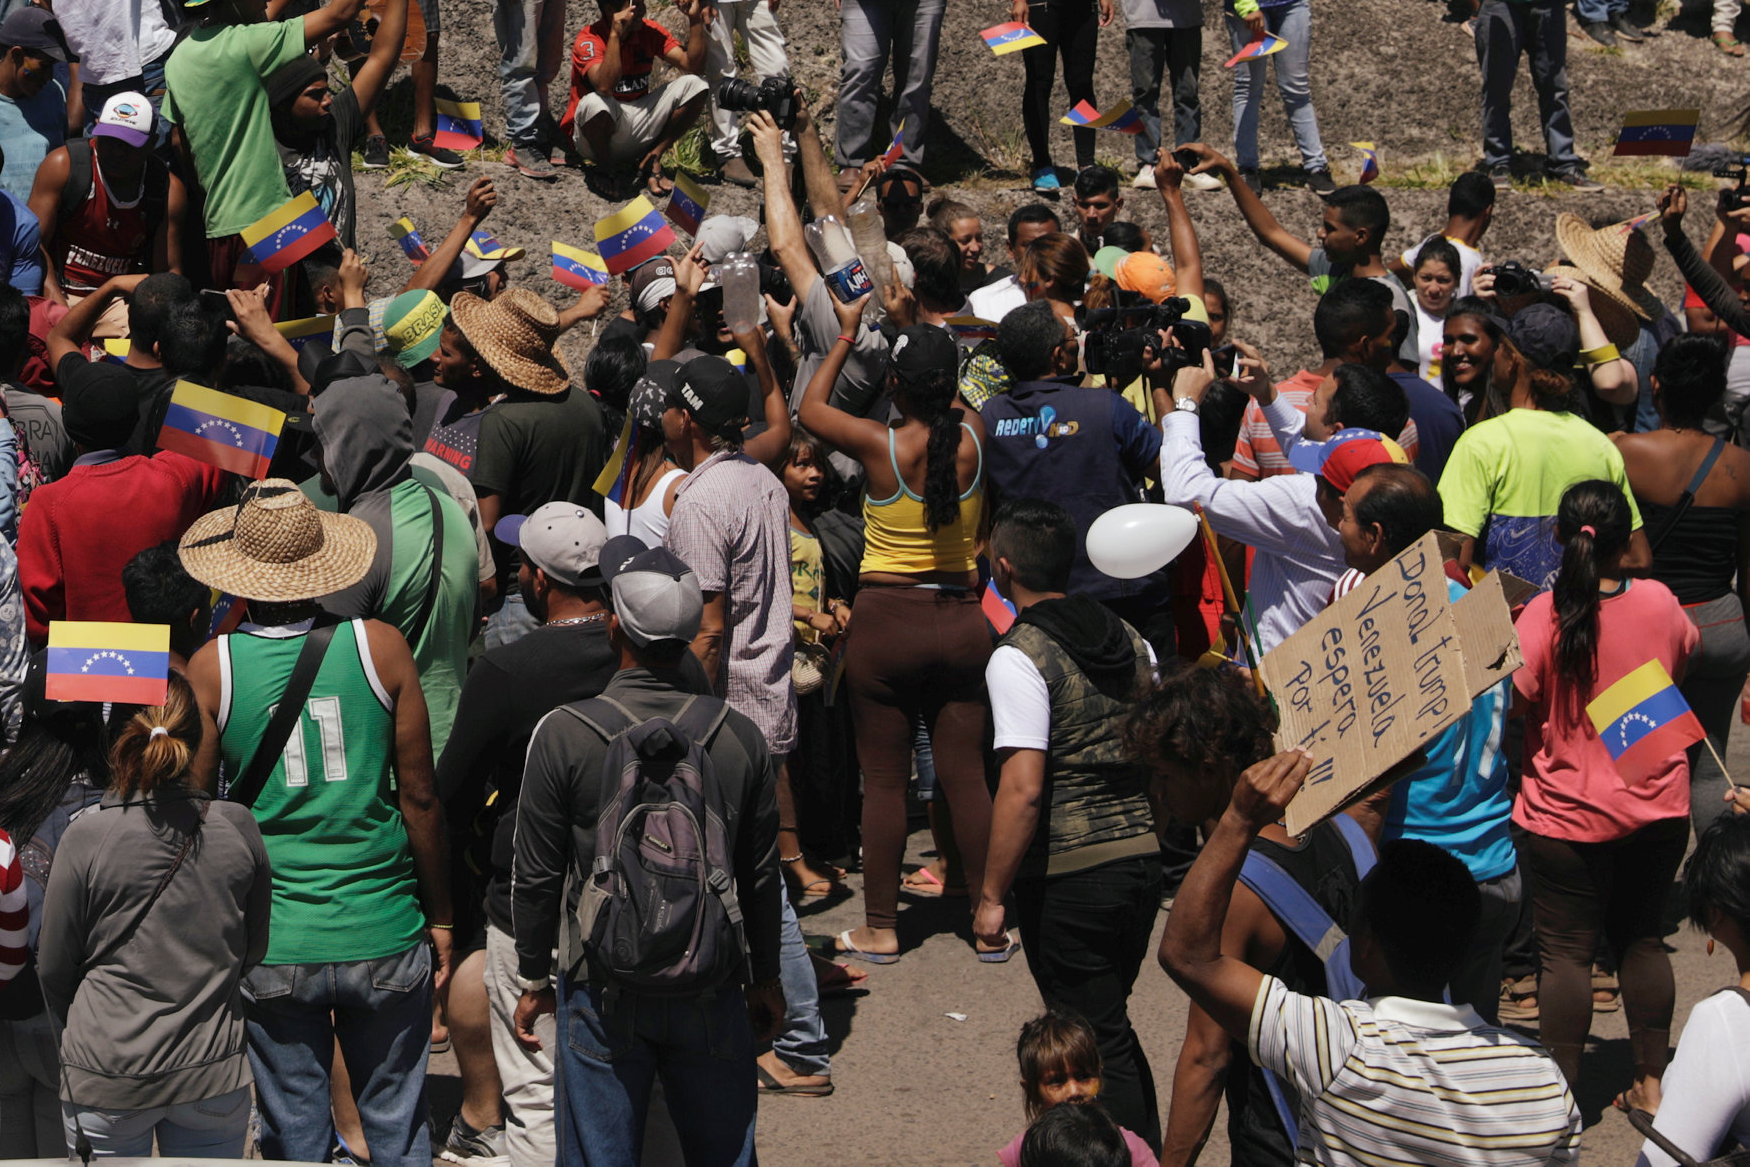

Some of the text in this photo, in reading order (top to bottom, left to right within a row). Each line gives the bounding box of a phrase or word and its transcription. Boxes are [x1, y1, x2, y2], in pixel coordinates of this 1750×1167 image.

[580, 41, 595, 61] 3
[681, 382, 704, 411] TAM
[424, 437, 472, 470] WARNING
[1316, 627, 1357, 739] espera
[1356, 585, 1406, 749] Venezuela
[269, 696, 348, 787] 11
